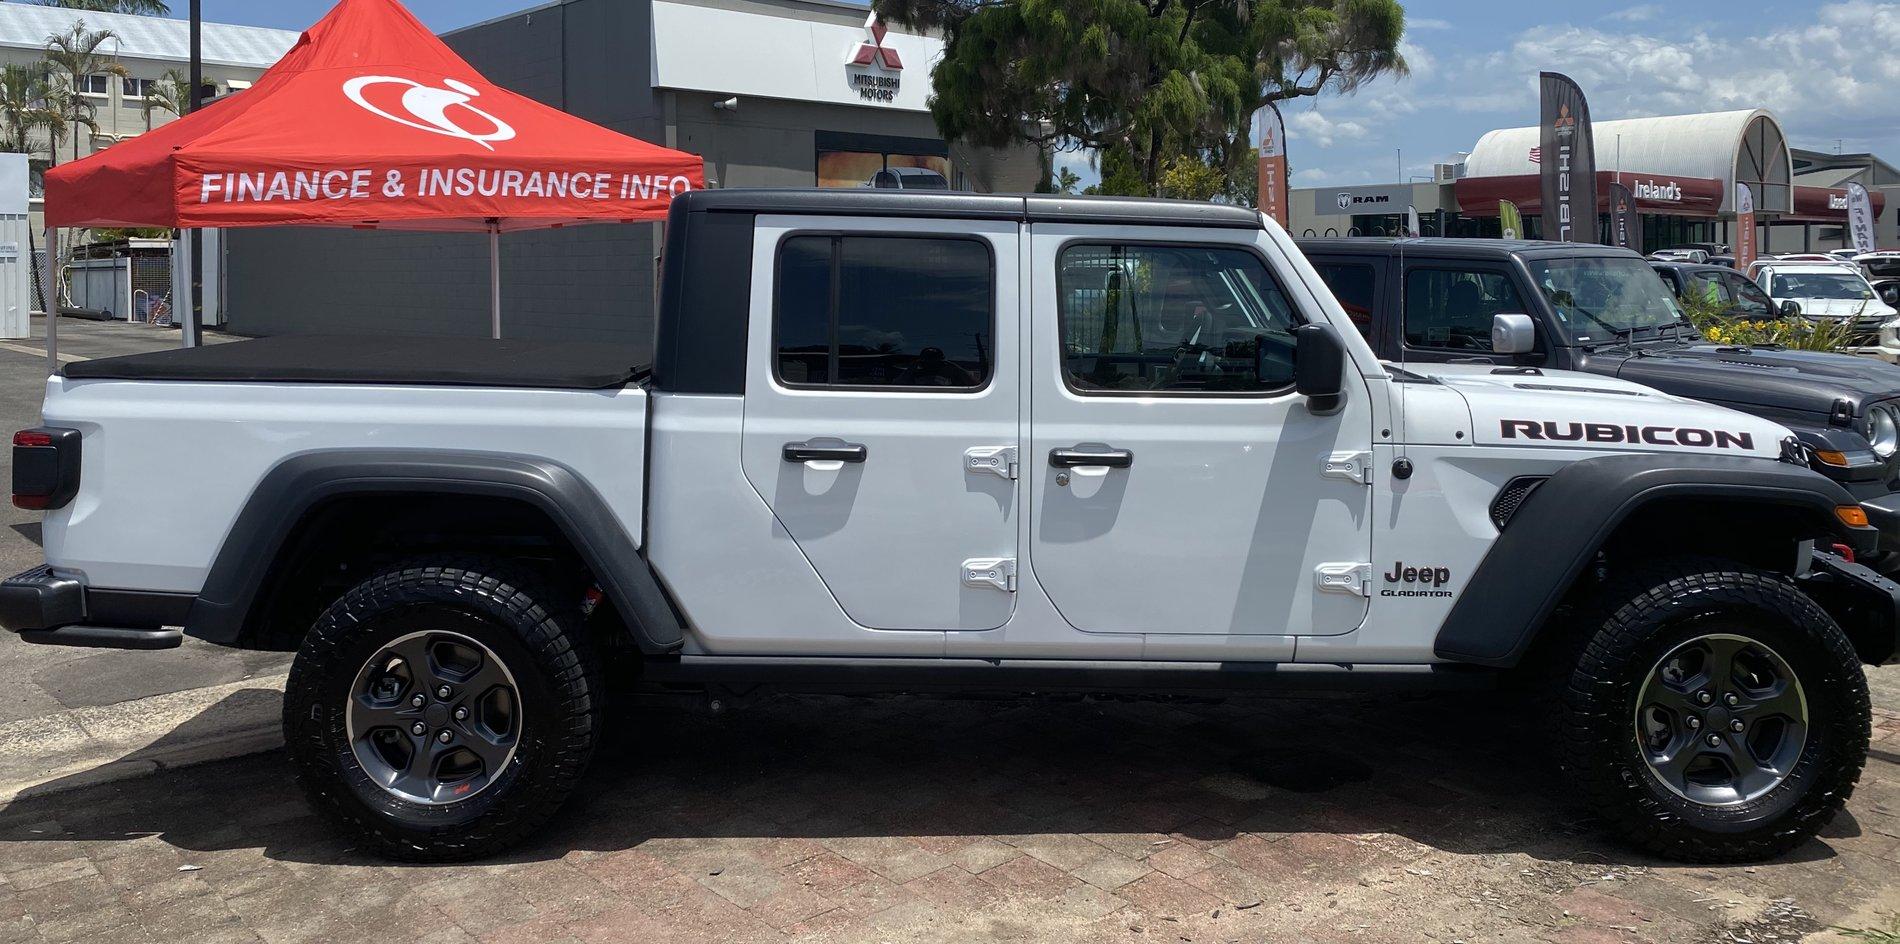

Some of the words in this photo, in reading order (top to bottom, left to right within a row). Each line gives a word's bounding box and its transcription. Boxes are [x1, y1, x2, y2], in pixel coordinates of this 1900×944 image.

[854, 73, 900, 89] MITSUBISHI
[860, 87, 893, 101] MOTORS
[201, 168, 373, 203] FINANCE
[382, 169, 405, 198] &
[418, 167, 612, 199] INSURANCE
[620, 174, 691, 200] INFO
[1633, 179, 1682, 201] Ireland's
[1353, 195, 1389, 204] RAM
[1500, 419, 1755, 451] RUBICON
[1384, 561, 1451, 588] Jeep
[1380, 589, 1453, 598] GLADIATOR
